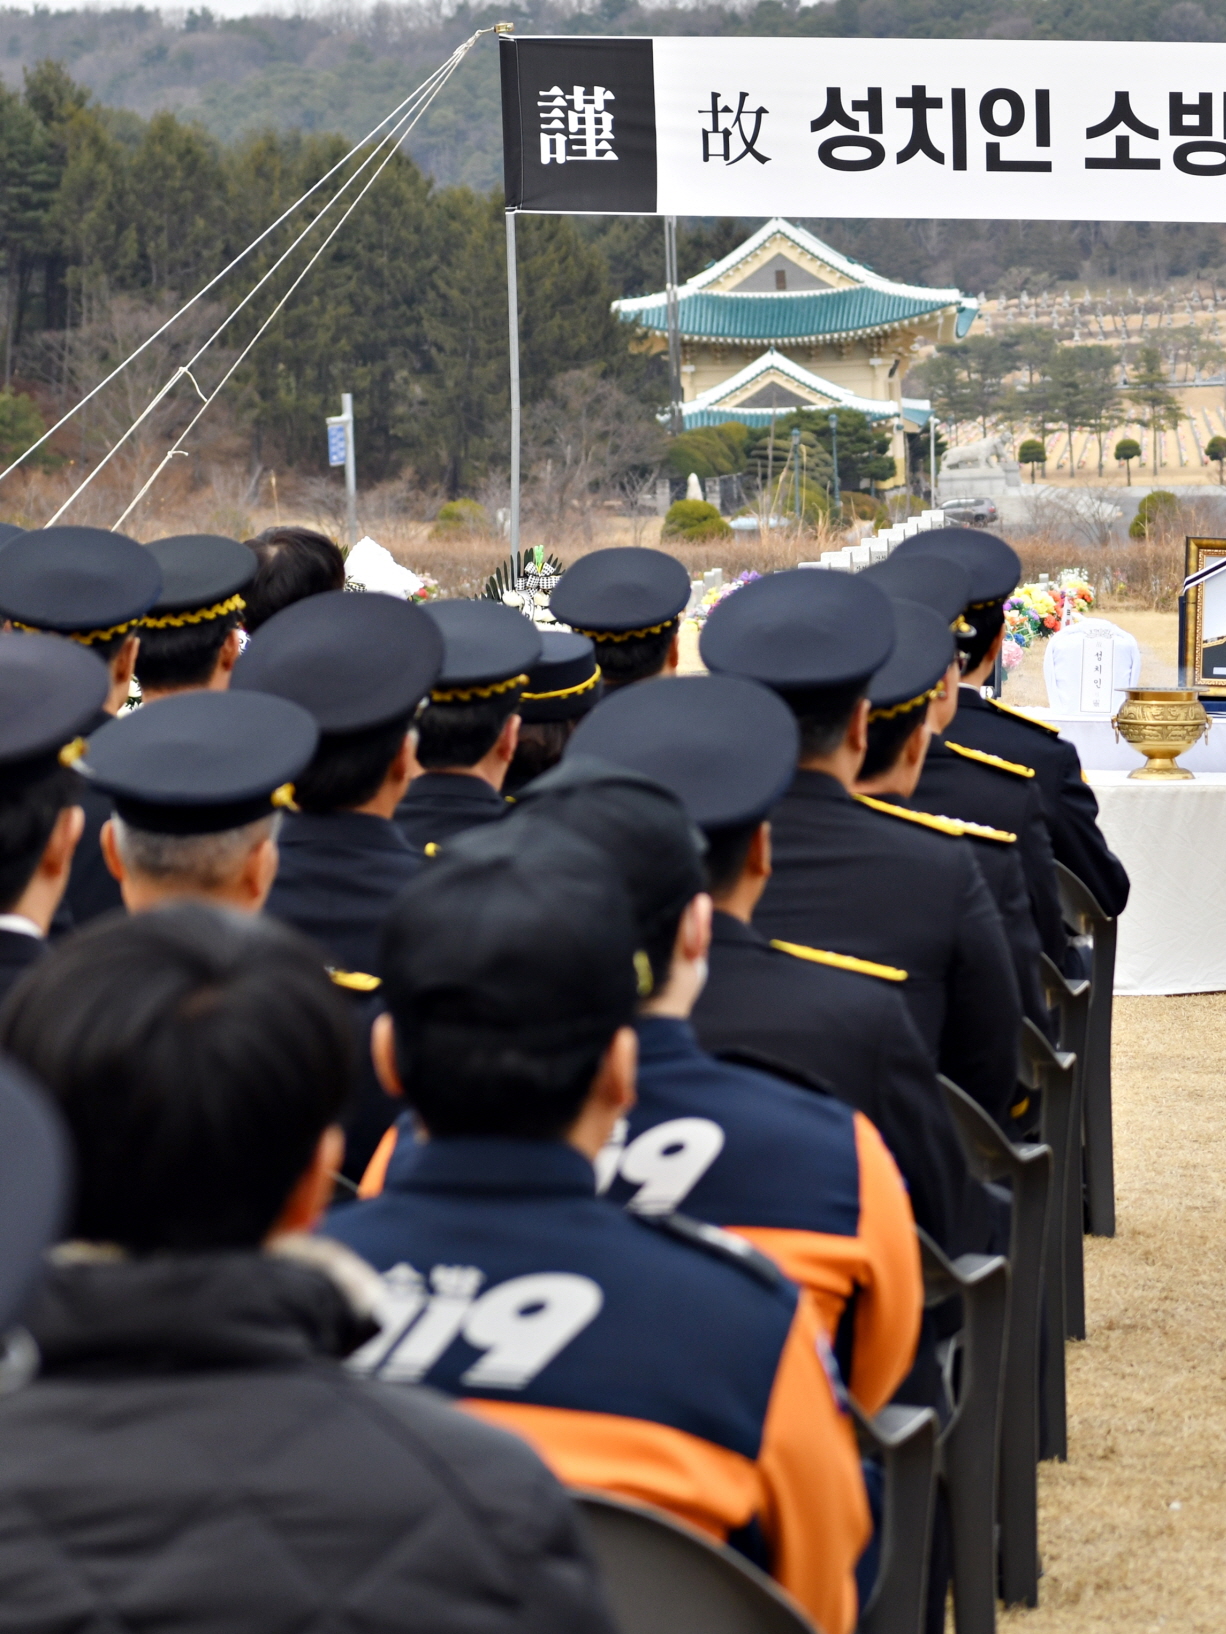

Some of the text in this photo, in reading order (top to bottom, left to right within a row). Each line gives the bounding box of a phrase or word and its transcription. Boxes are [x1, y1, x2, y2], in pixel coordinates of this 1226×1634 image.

[536, 85, 619, 165] 謹
[697, 91, 772, 166] 故
[810, 84, 1053, 173] 성치인
[1094, 650, 1103, 689] 성치인
[342, 1271, 604, 1390] 119
